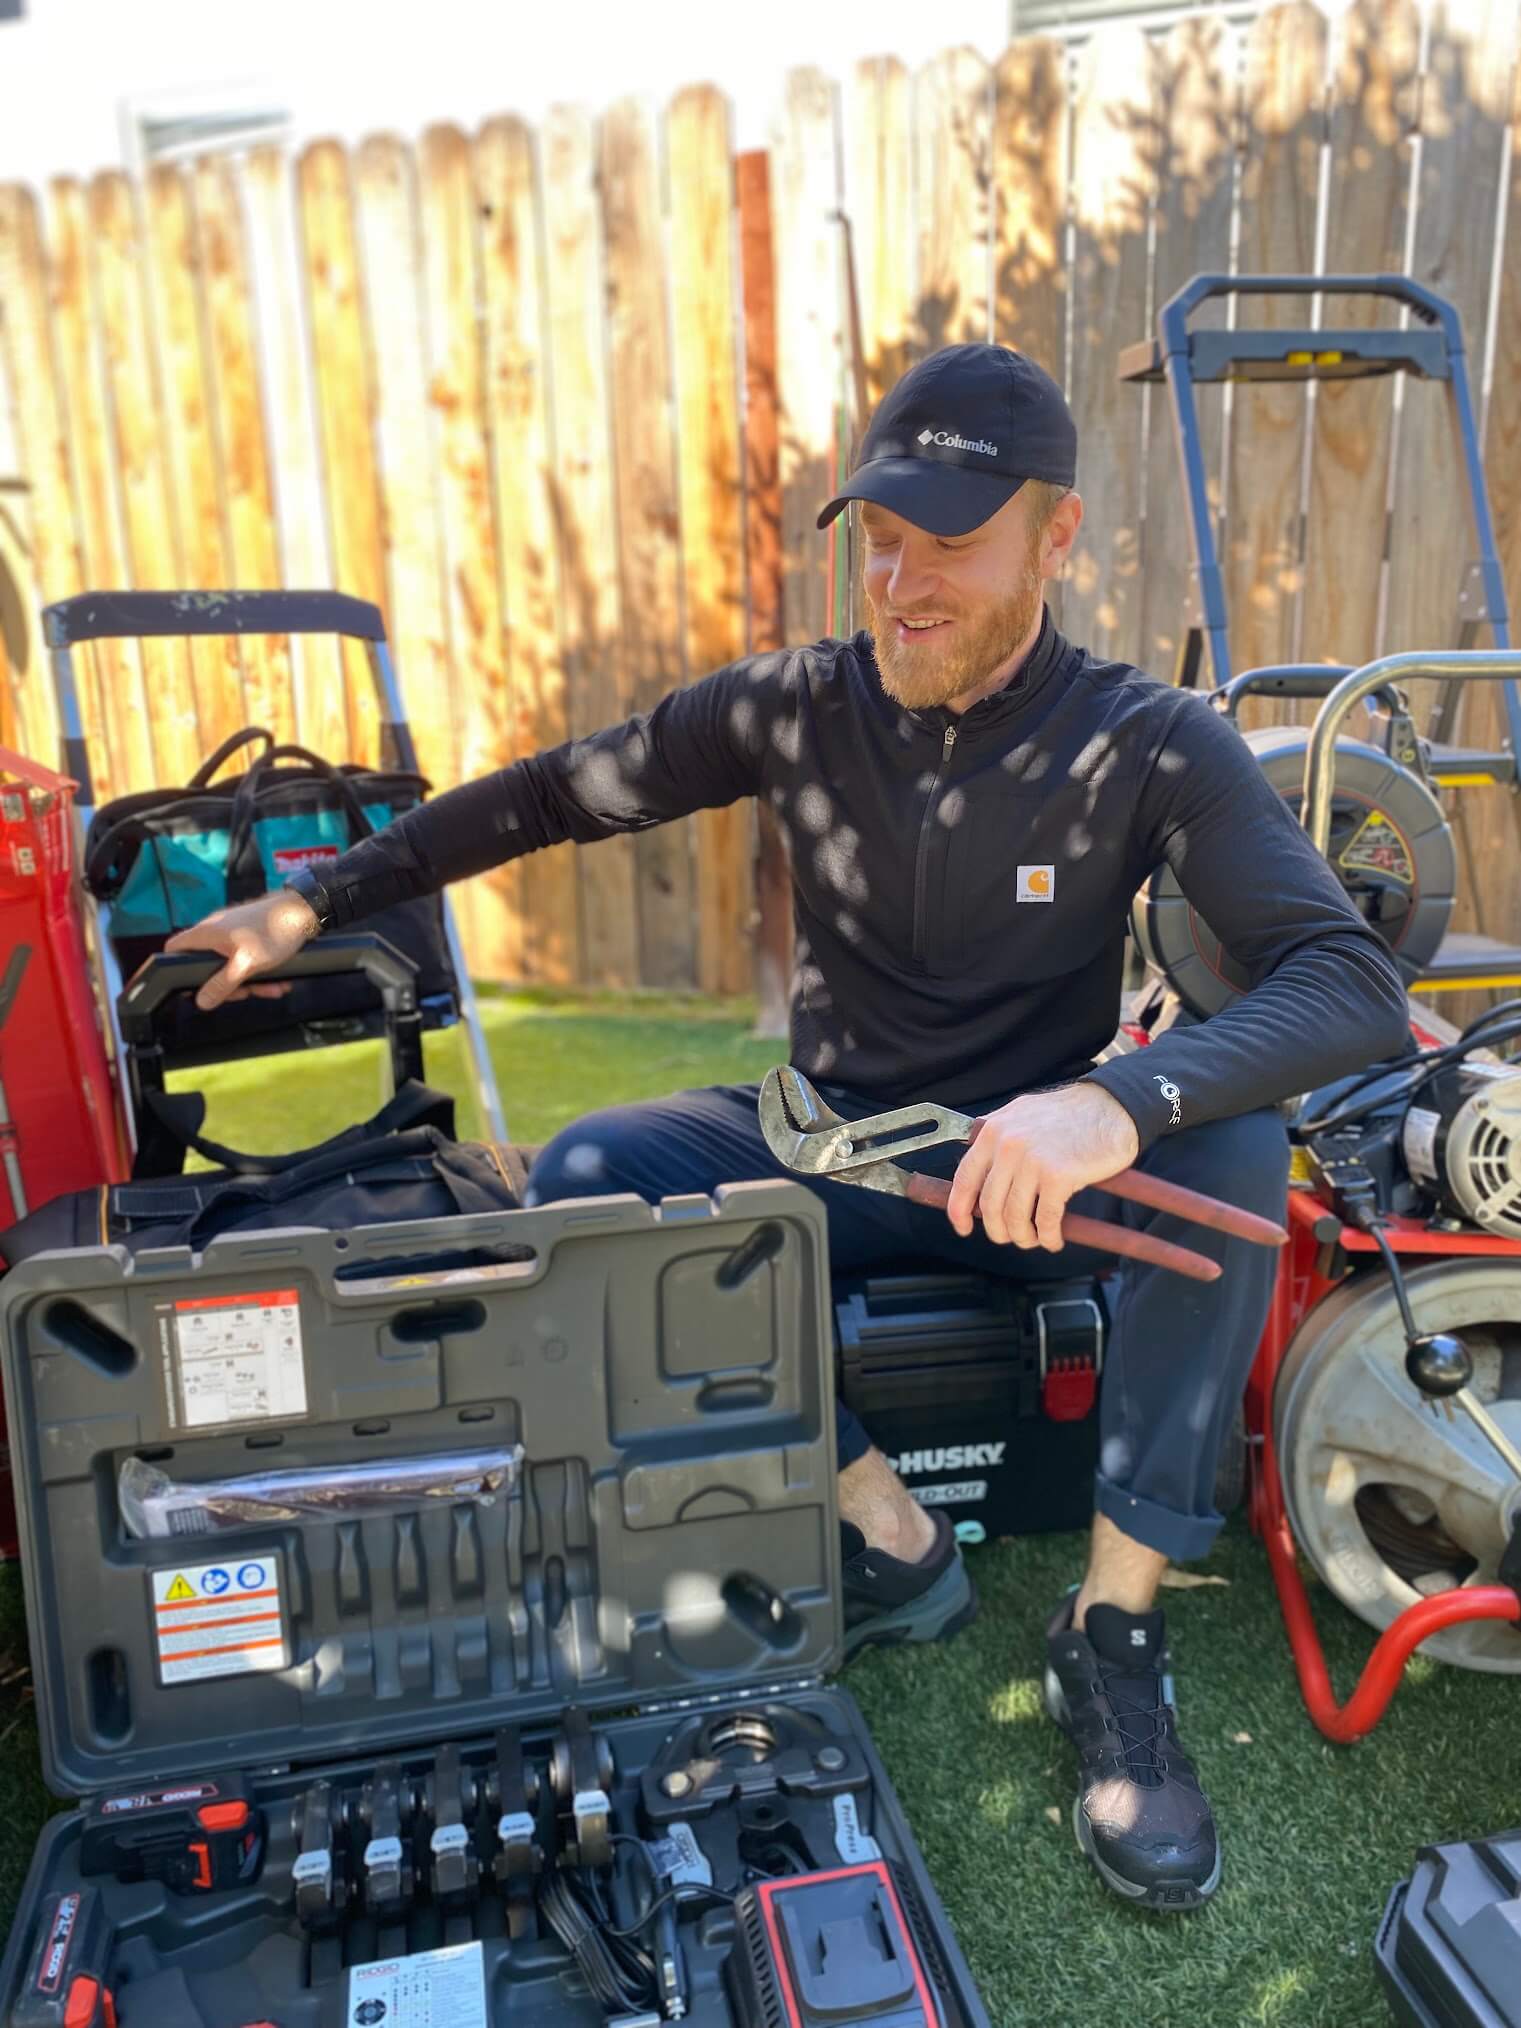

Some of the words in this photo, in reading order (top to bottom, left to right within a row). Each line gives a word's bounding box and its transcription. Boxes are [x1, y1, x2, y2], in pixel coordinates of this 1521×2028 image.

[933, 431, 998, 456] Columbia
[1152, 1075, 1181, 1125] FORCE
[900, 1441, 1006, 1475] HUSKY
[911, 1483, 979, 1502] LD-OUT
[1131, 1629, 1147, 1646] S
